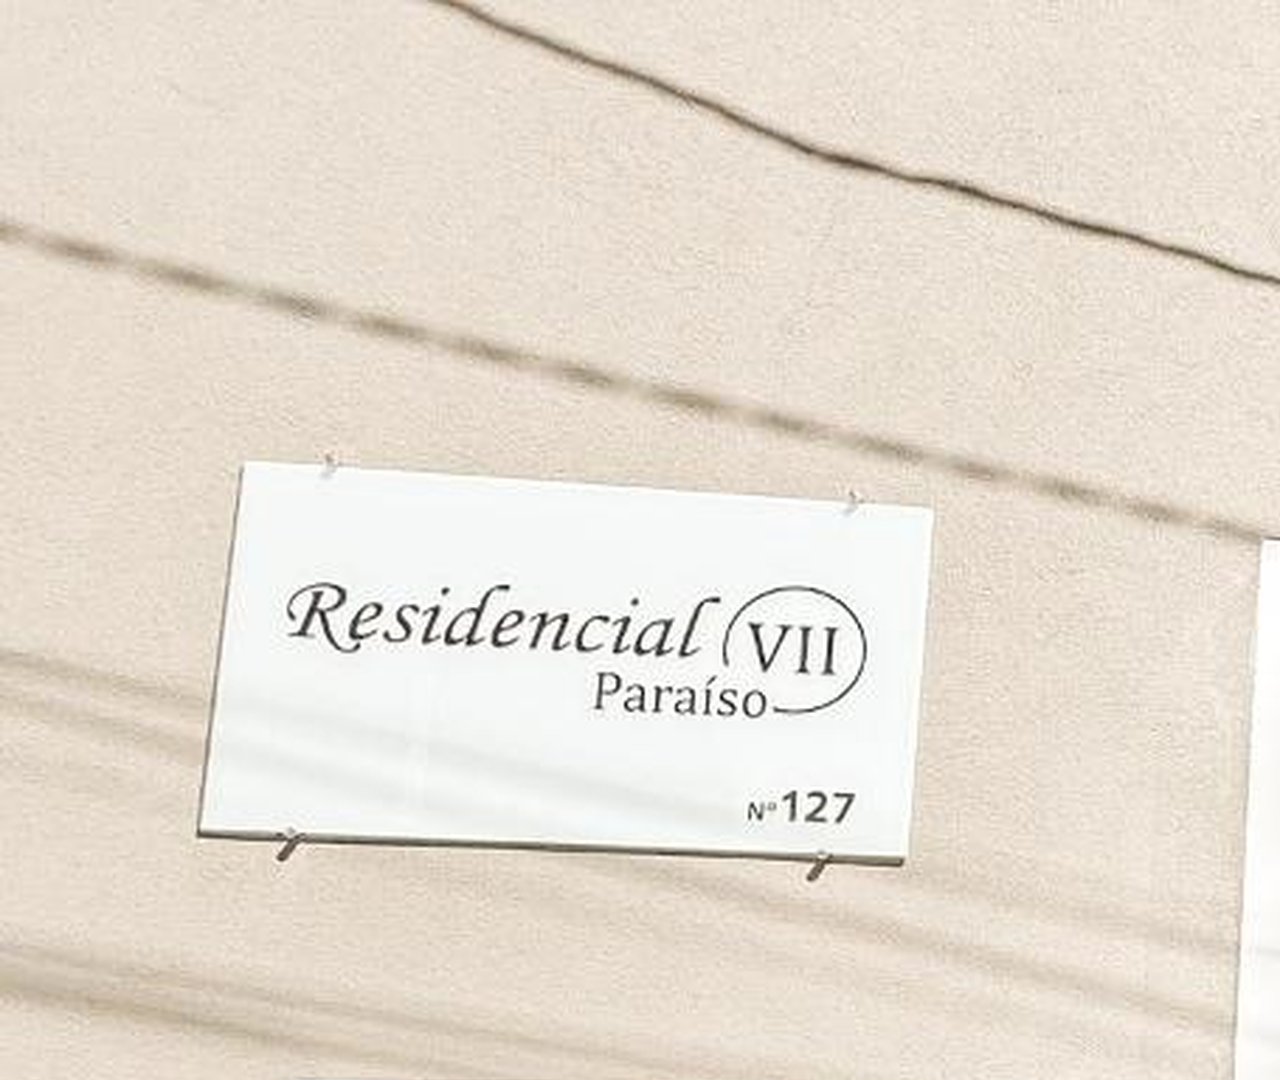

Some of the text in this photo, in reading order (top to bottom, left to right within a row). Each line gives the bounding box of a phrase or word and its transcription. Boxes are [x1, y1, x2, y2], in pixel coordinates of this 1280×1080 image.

[285, 583, 840, 676] Residencial VII
[594, 672, 767, 720] Paraíso
